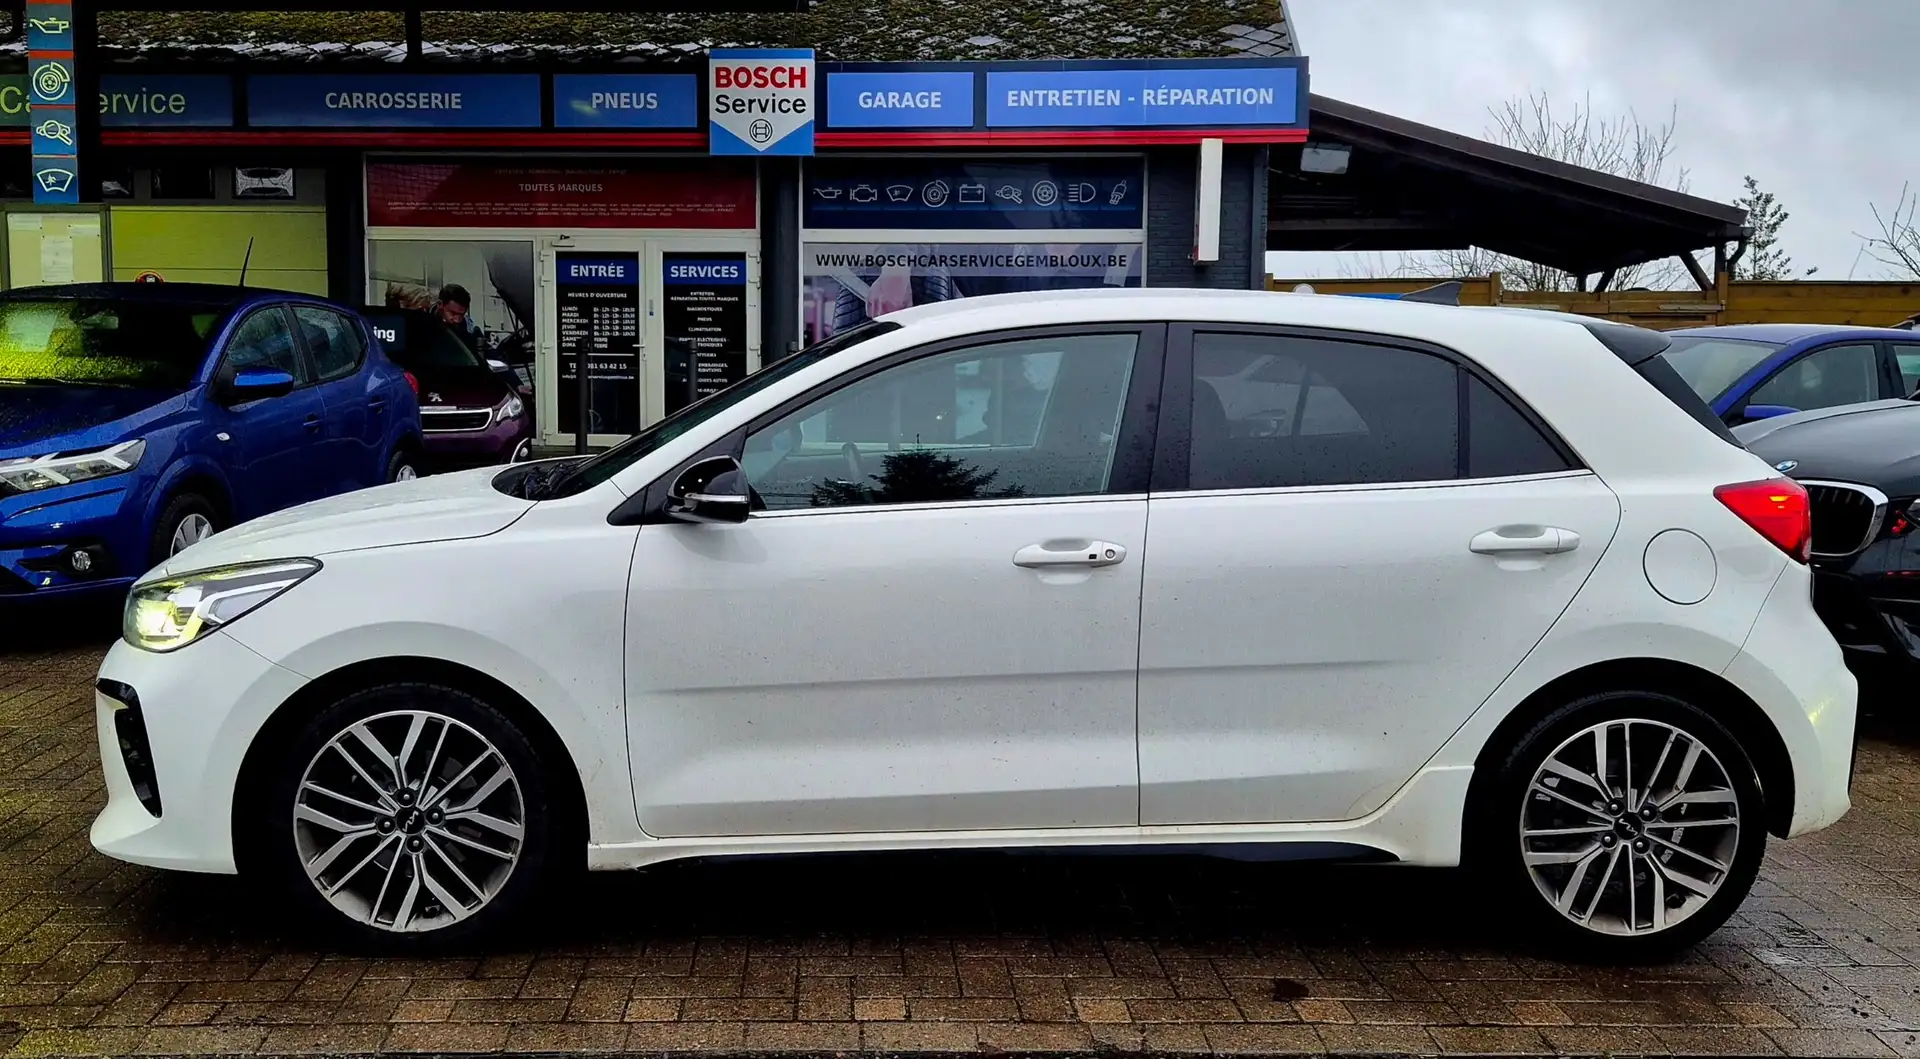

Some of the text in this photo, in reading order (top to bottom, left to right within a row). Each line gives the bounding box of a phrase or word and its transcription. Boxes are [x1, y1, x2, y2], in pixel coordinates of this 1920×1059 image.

[714, 66, 807, 89] BOSCH
[99, 87, 186, 114] ervice
[325, 92, 462, 110] CARROSSERIE
[591, 92, 658, 110] PNEUS
[714, 93, 807, 114] Service
[858, 91, 942, 109] GARAGE
[1007, 89, 1122, 108] ENTRETIEN
[1142, 84, 1274, 107] RÉPARATION
[519, 183, 604, 194] TOUTES MARQUES
[816, 253, 1127, 268] WWW.BOSCHCARSERVICEGEMBLOUX.BE
[571, 262, 624, 278] ENTRÉE
[670, 265, 739, 279] SERVICES
